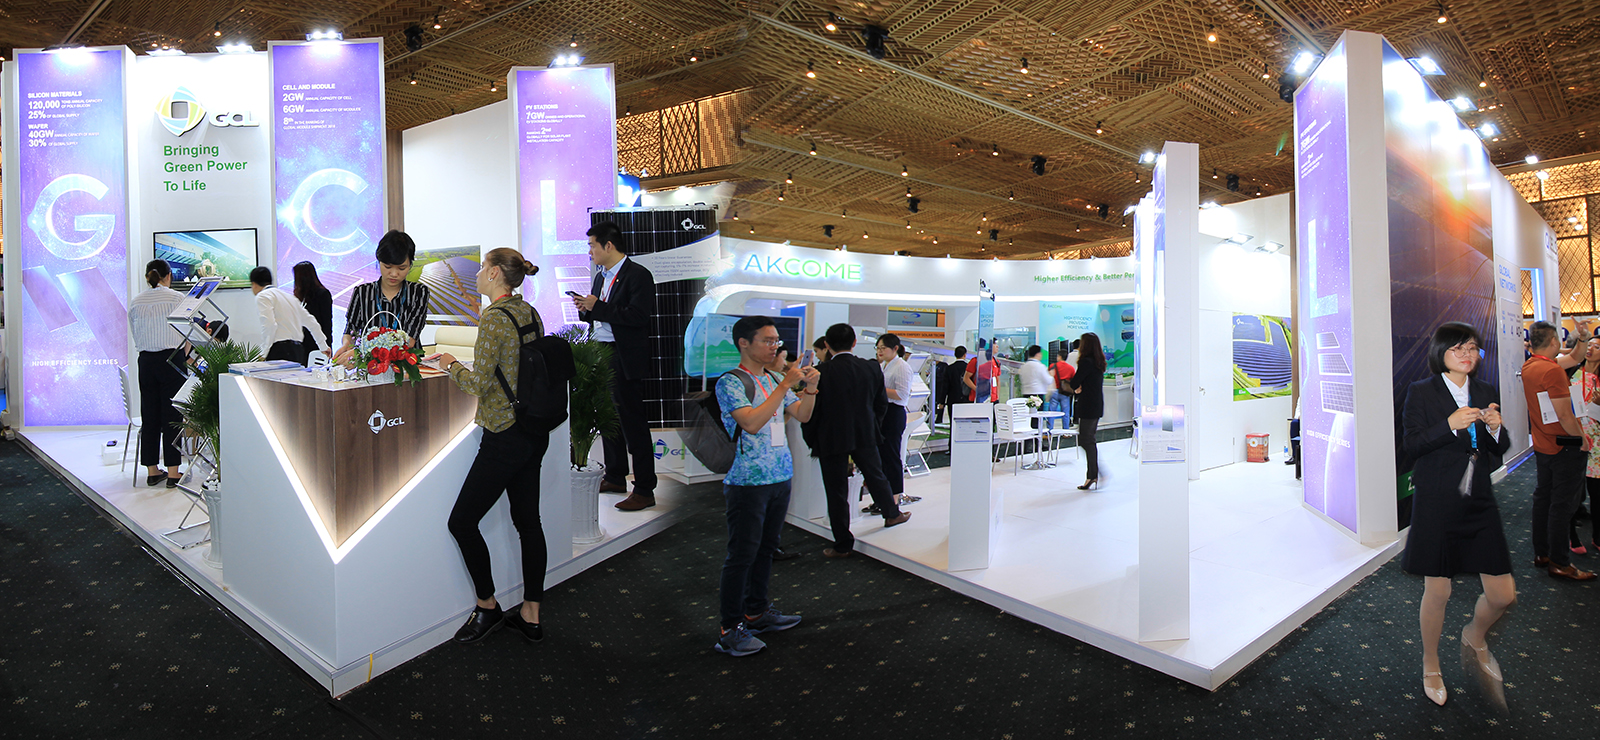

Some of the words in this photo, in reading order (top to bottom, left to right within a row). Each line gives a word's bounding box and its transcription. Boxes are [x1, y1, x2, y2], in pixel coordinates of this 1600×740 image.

[283, 93, 304, 101] 2GW
[28, 100, 60, 109] 120,000
[283, 105, 304, 113] 6GW
[28, 110, 46, 119] 25%
[209, 111, 260, 128] GCL
[526, 111, 545, 119] 7GW
[283, 117, 294, 125] 8th
[28, 130, 54, 138] 40GW
[29, 139, 47, 147] 30%
[164, 144, 219, 158] Bringing
[164, 162, 202, 172] Green
[207, 160, 248, 170] Power
[164, 181, 178, 191] To
[183, 180, 206, 190] Life
[30, 174, 116, 260] G
[289, 168, 370, 256] C
[540, 180, 590, 255] L
[744, 254, 861, 280] AKCOME
[1308, 218, 1338, 318] L
[1034, 275, 1059, 283] Higher
[387, 417, 405, 427] GCL
